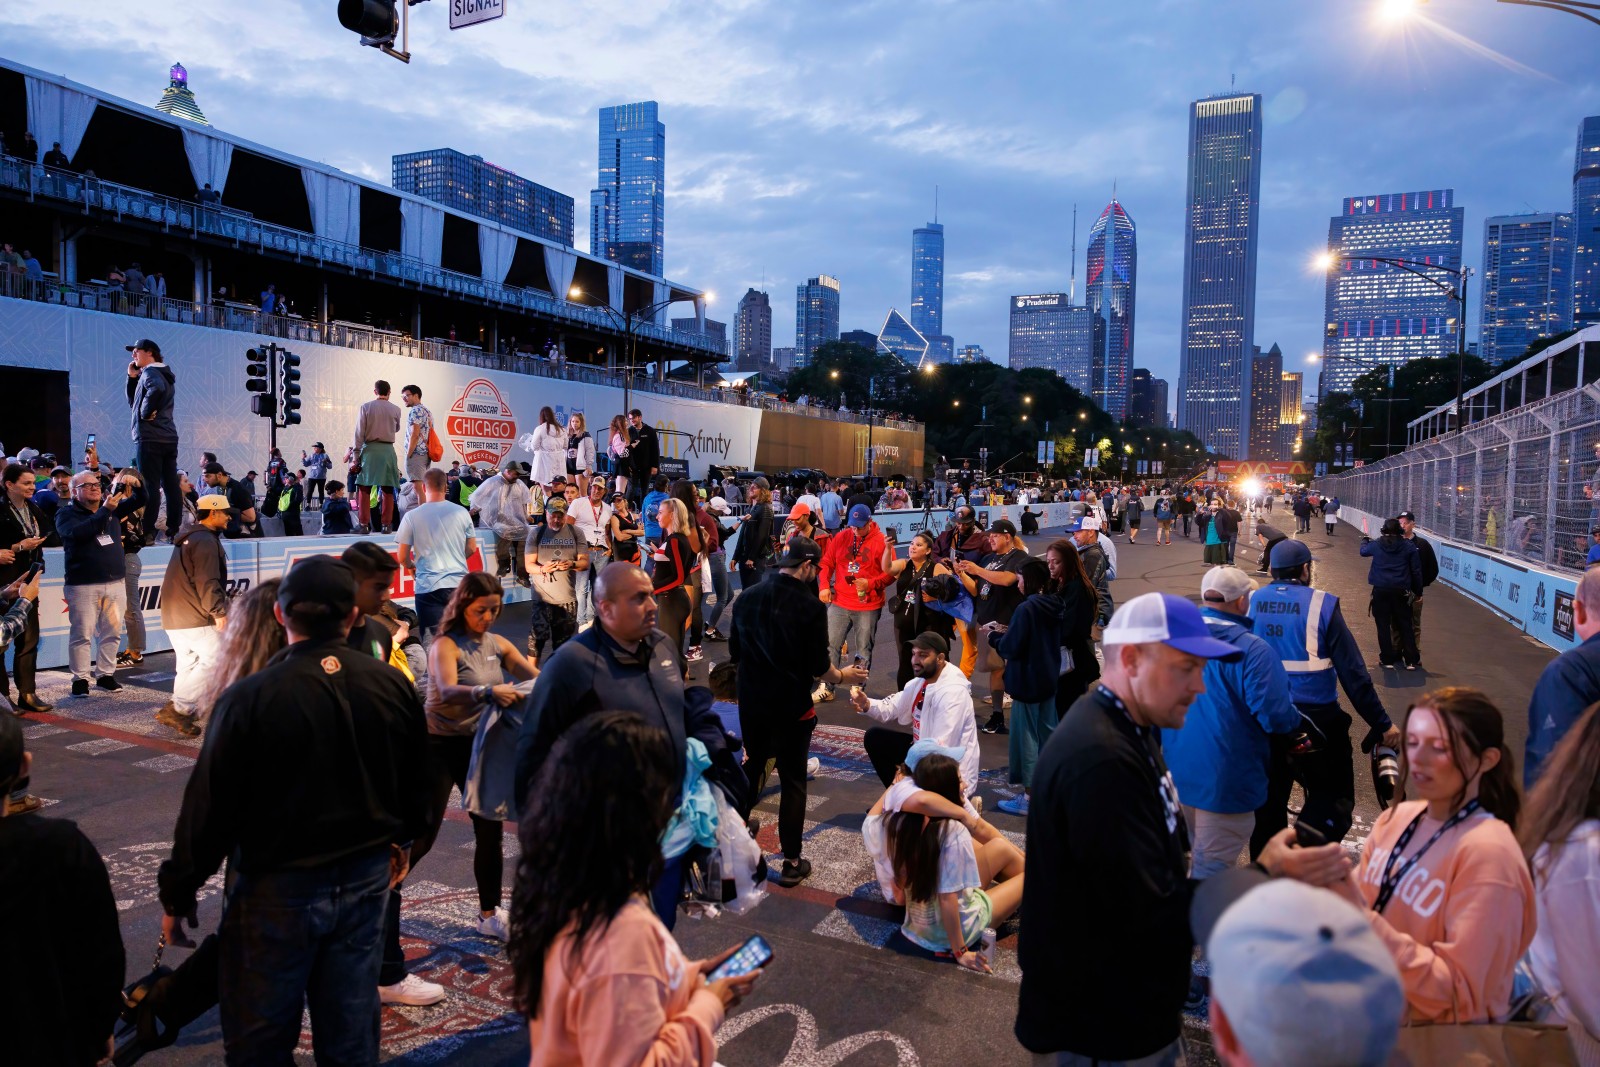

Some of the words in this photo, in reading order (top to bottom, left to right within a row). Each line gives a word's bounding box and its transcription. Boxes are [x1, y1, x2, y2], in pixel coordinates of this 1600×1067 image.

[1026, 298, 1059, 306] Prudential
[470, 403, 498, 414] NASCAR
[454, 418, 510, 437] CHICAGO
[466, 441, 486, 449] STREET
[486, 442, 499, 450] RACE
[688, 428, 732, 460] xfinity
[467, 452, 497, 462] WEEKEND
[1256, 601, 1300, 615] MEDIA
[1266, 623, 1284, 637] 38
